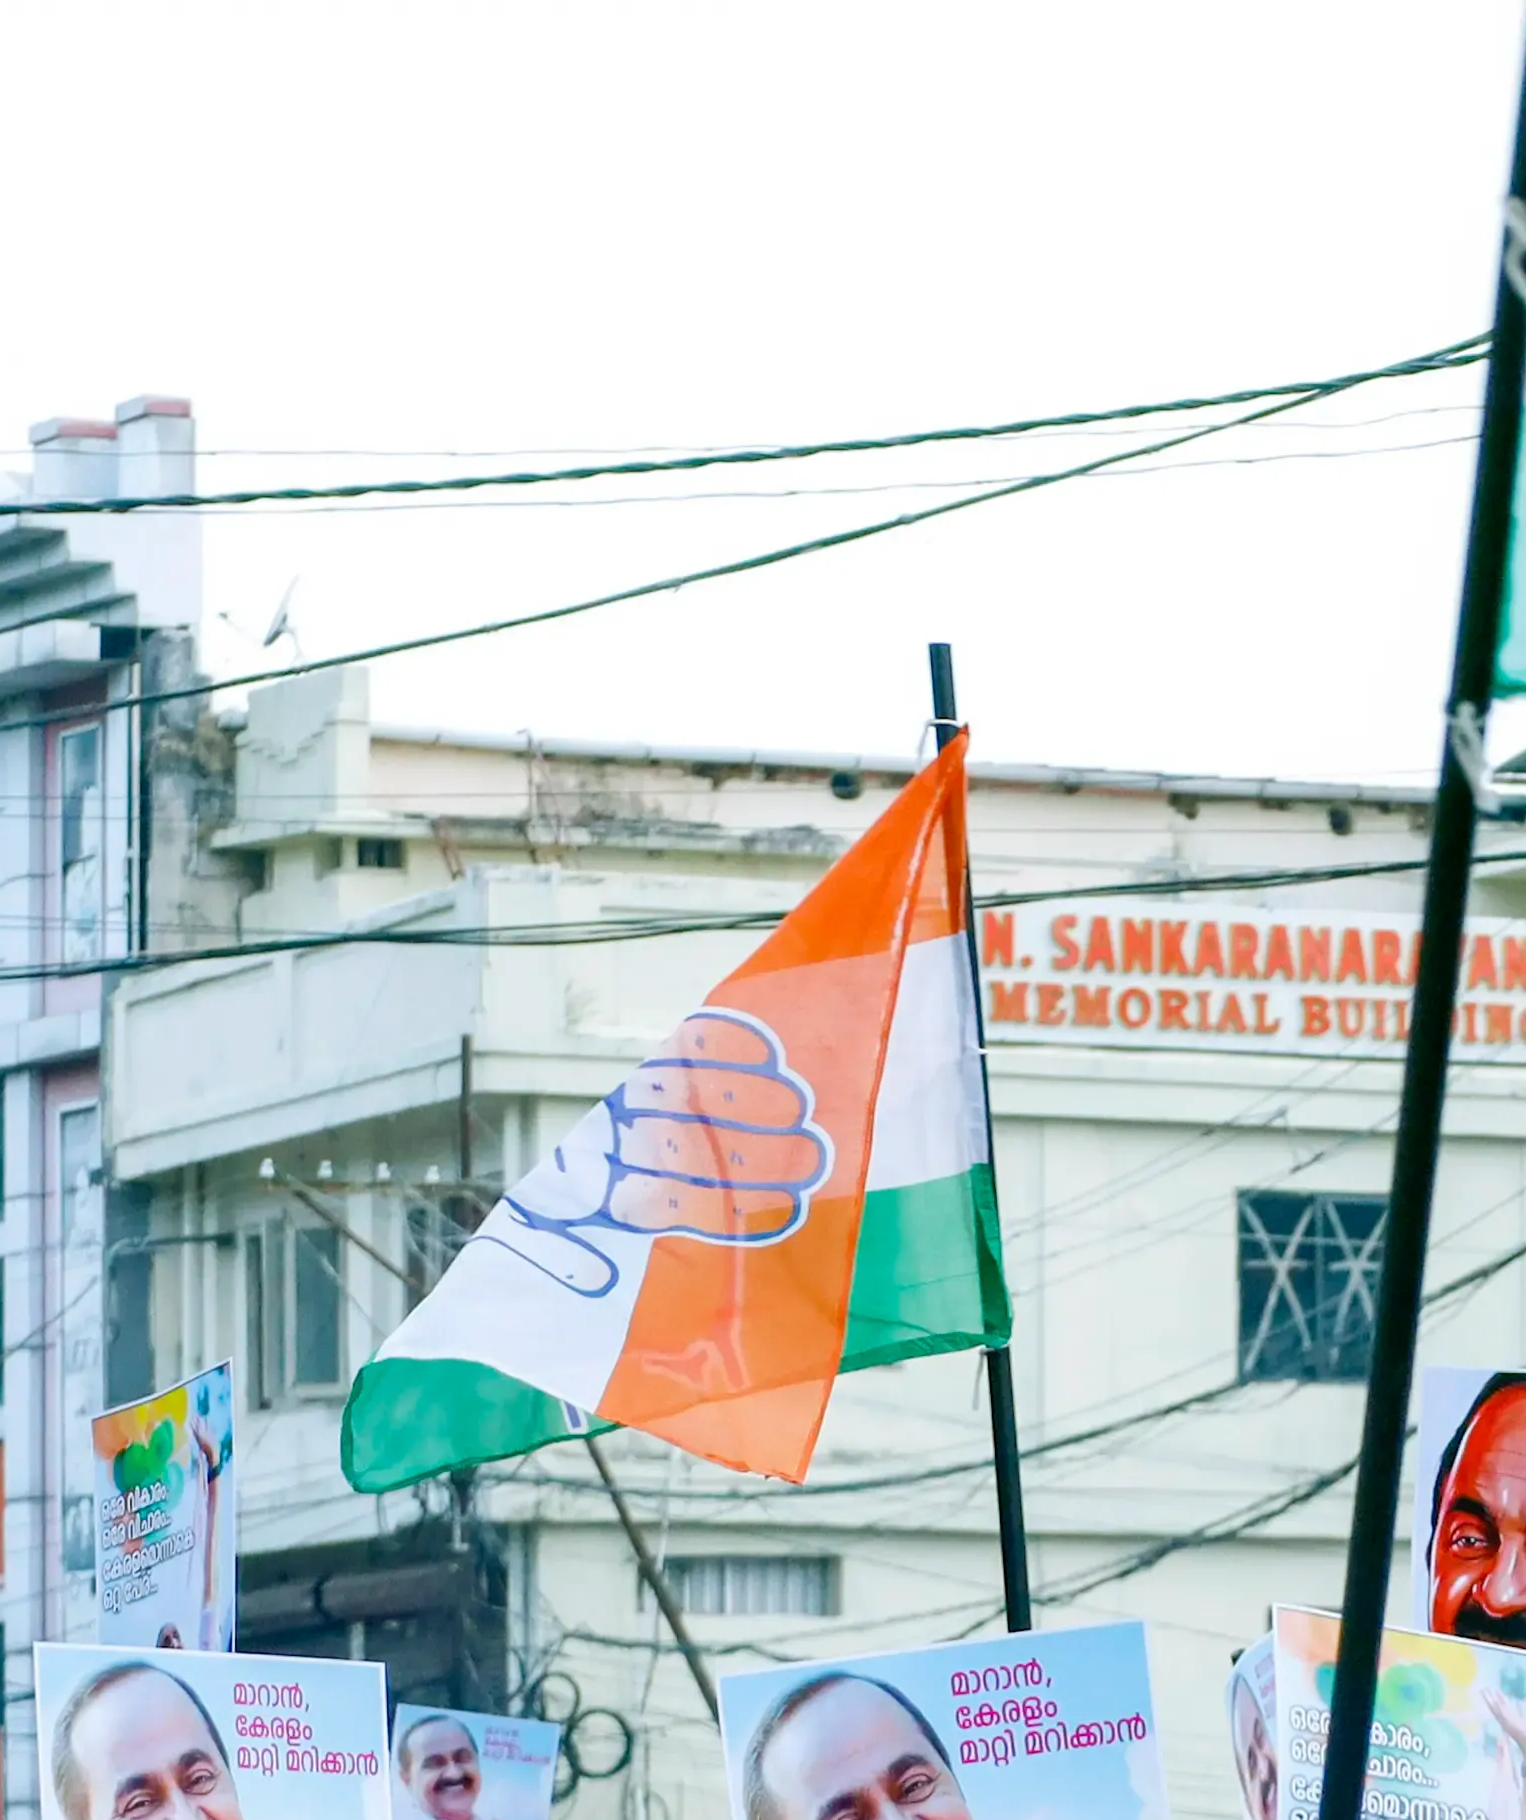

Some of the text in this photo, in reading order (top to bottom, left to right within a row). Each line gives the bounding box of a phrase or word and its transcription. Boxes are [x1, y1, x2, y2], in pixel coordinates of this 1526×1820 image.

[990, 981, 1281, 1037] MEMORIAL
[949, 1658, 1054, 1697] മാറാൻ,
[231, 1680, 312, 1716] മാറാൻ,
[955, 1696, 1059, 1730] കേരളം
[234, 1716, 314, 1747] കേരളം
[958, 1711, 1148, 1768] മാറ്റി മറിക്കാൻ
[235, 1744, 380, 1779] മാറ്റി മറിക്കാൻ
